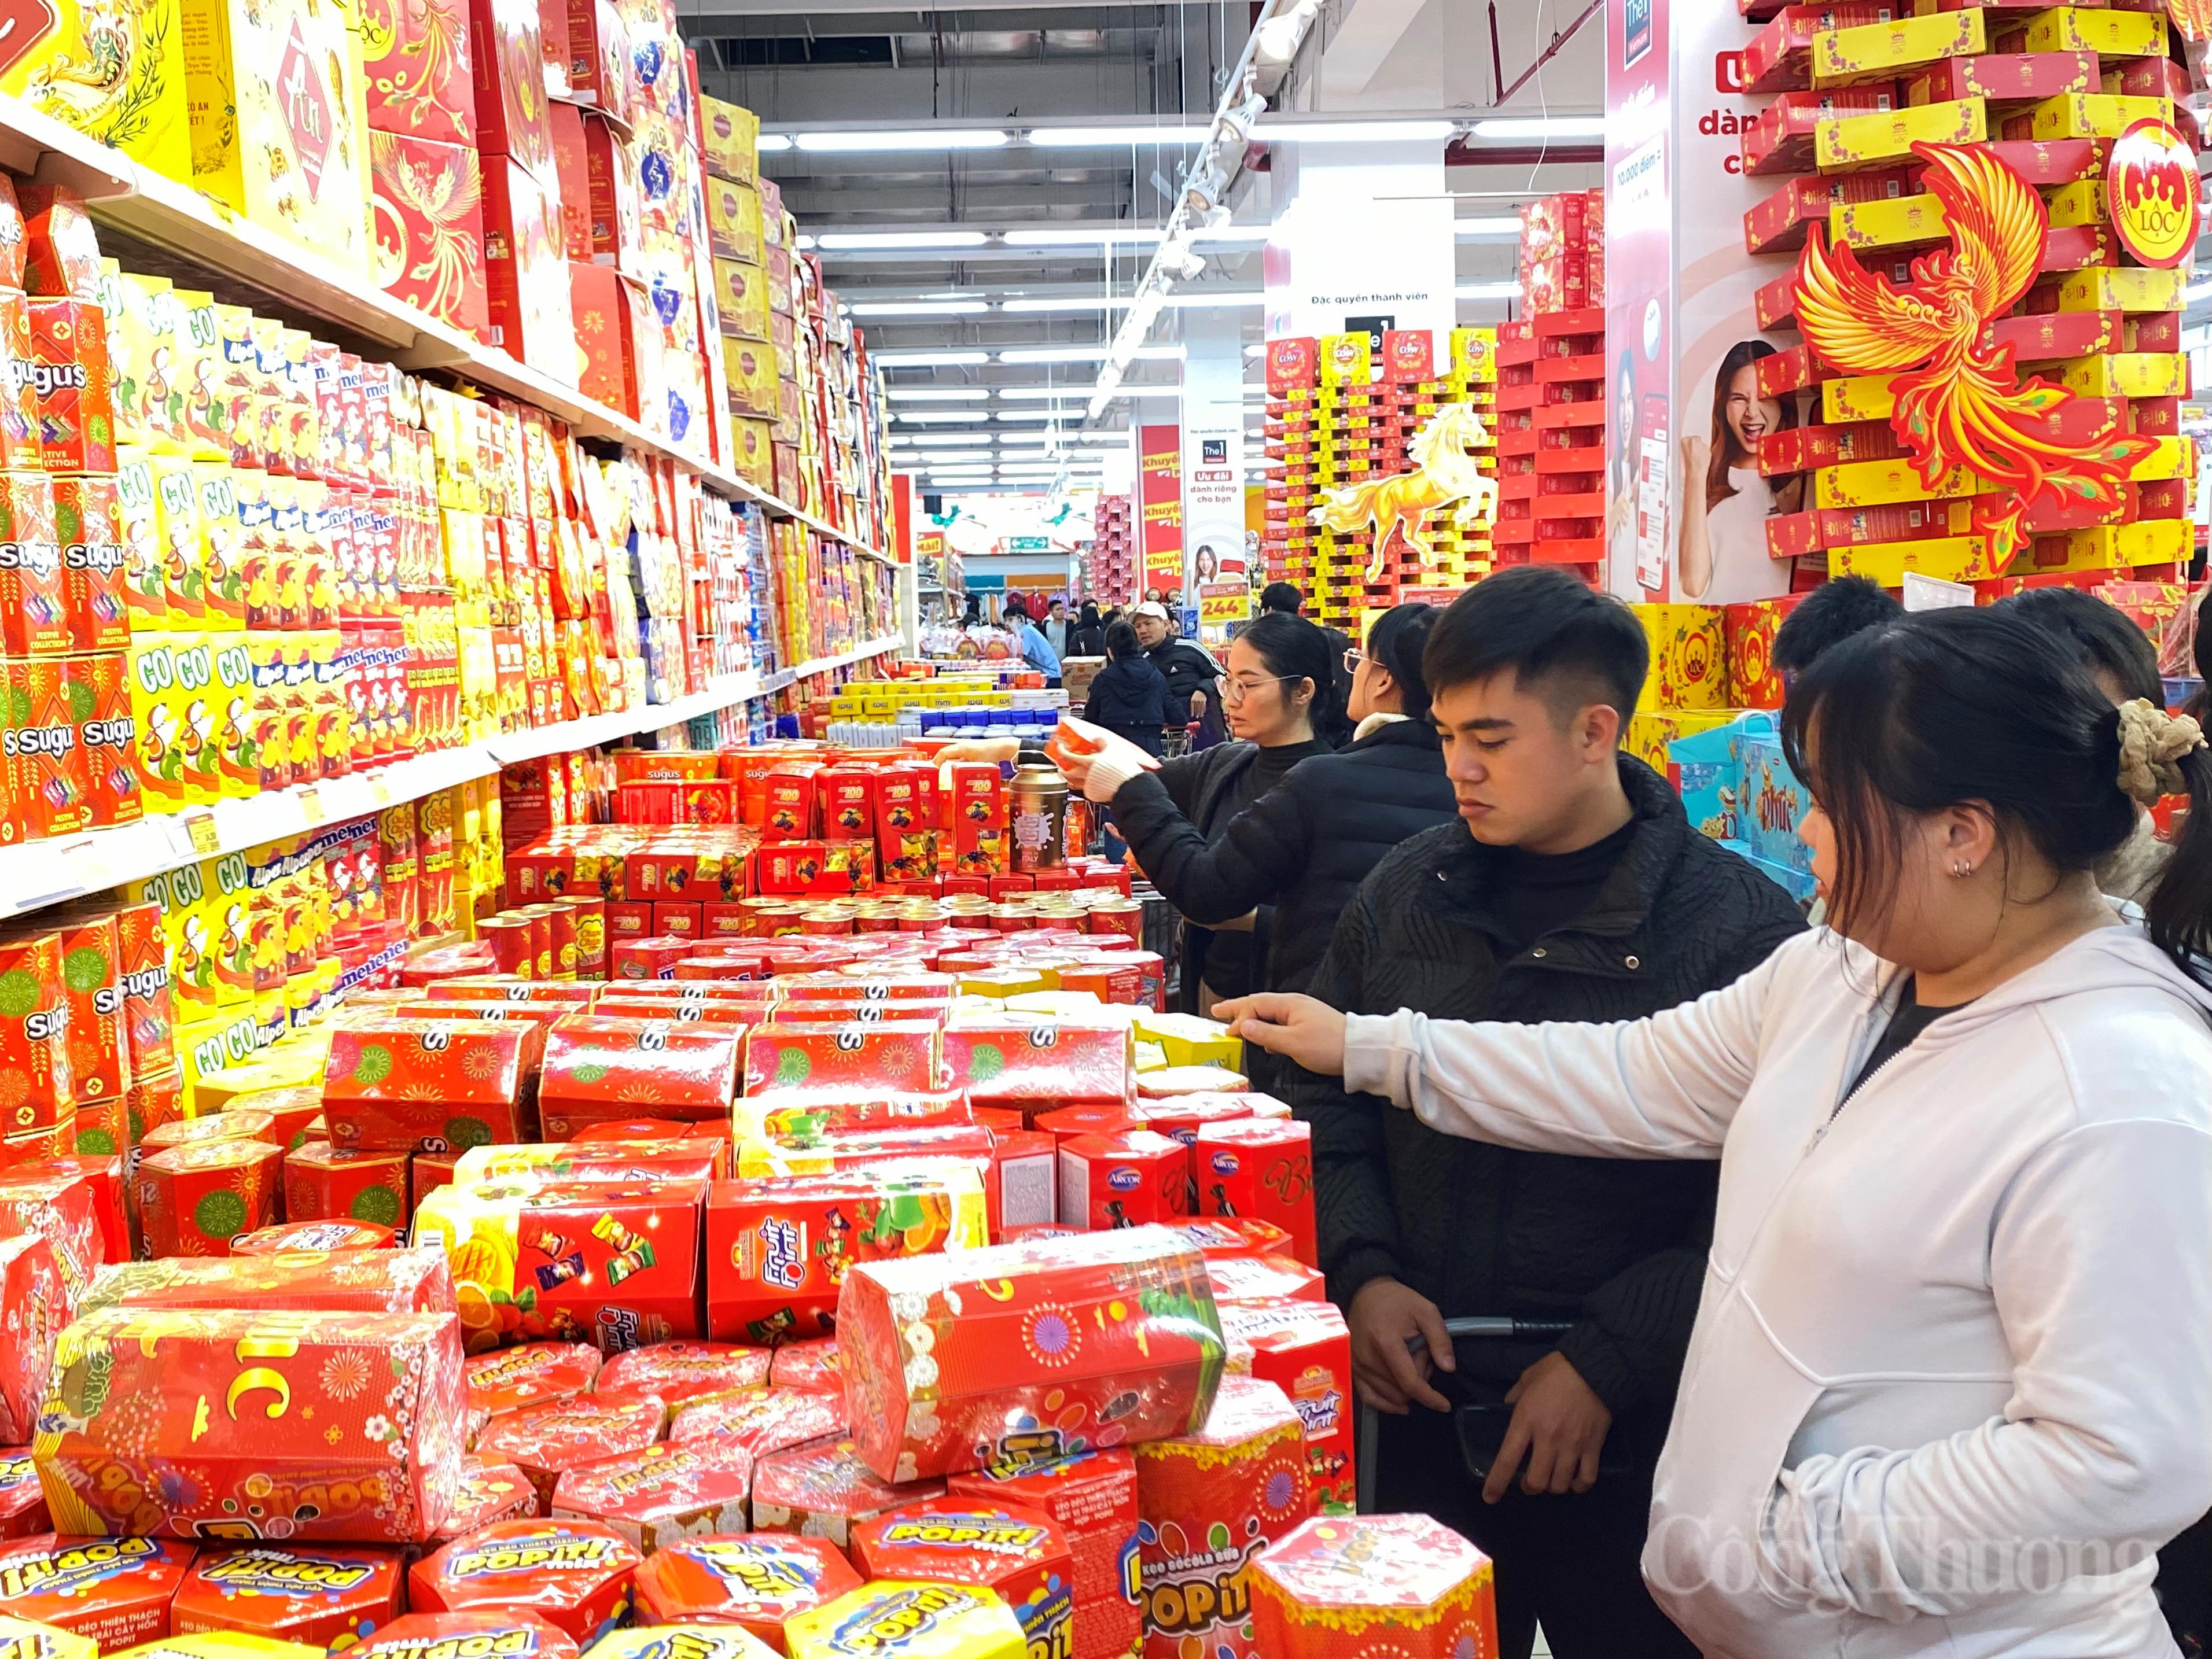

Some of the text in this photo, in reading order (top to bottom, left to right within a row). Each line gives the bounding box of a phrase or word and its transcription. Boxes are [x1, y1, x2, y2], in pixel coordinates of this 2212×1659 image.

[359, 19, 381, 45] ỘC
[2140, 201, 2176, 238] LỘC
[43, 458, 79, 467] ECTION
[1190, 485, 1212, 493] dành
[1202, 600, 1239, 616] 244
[647, 769, 681, 782] sugus
[109, 1635, 137, 1647] POPIT
